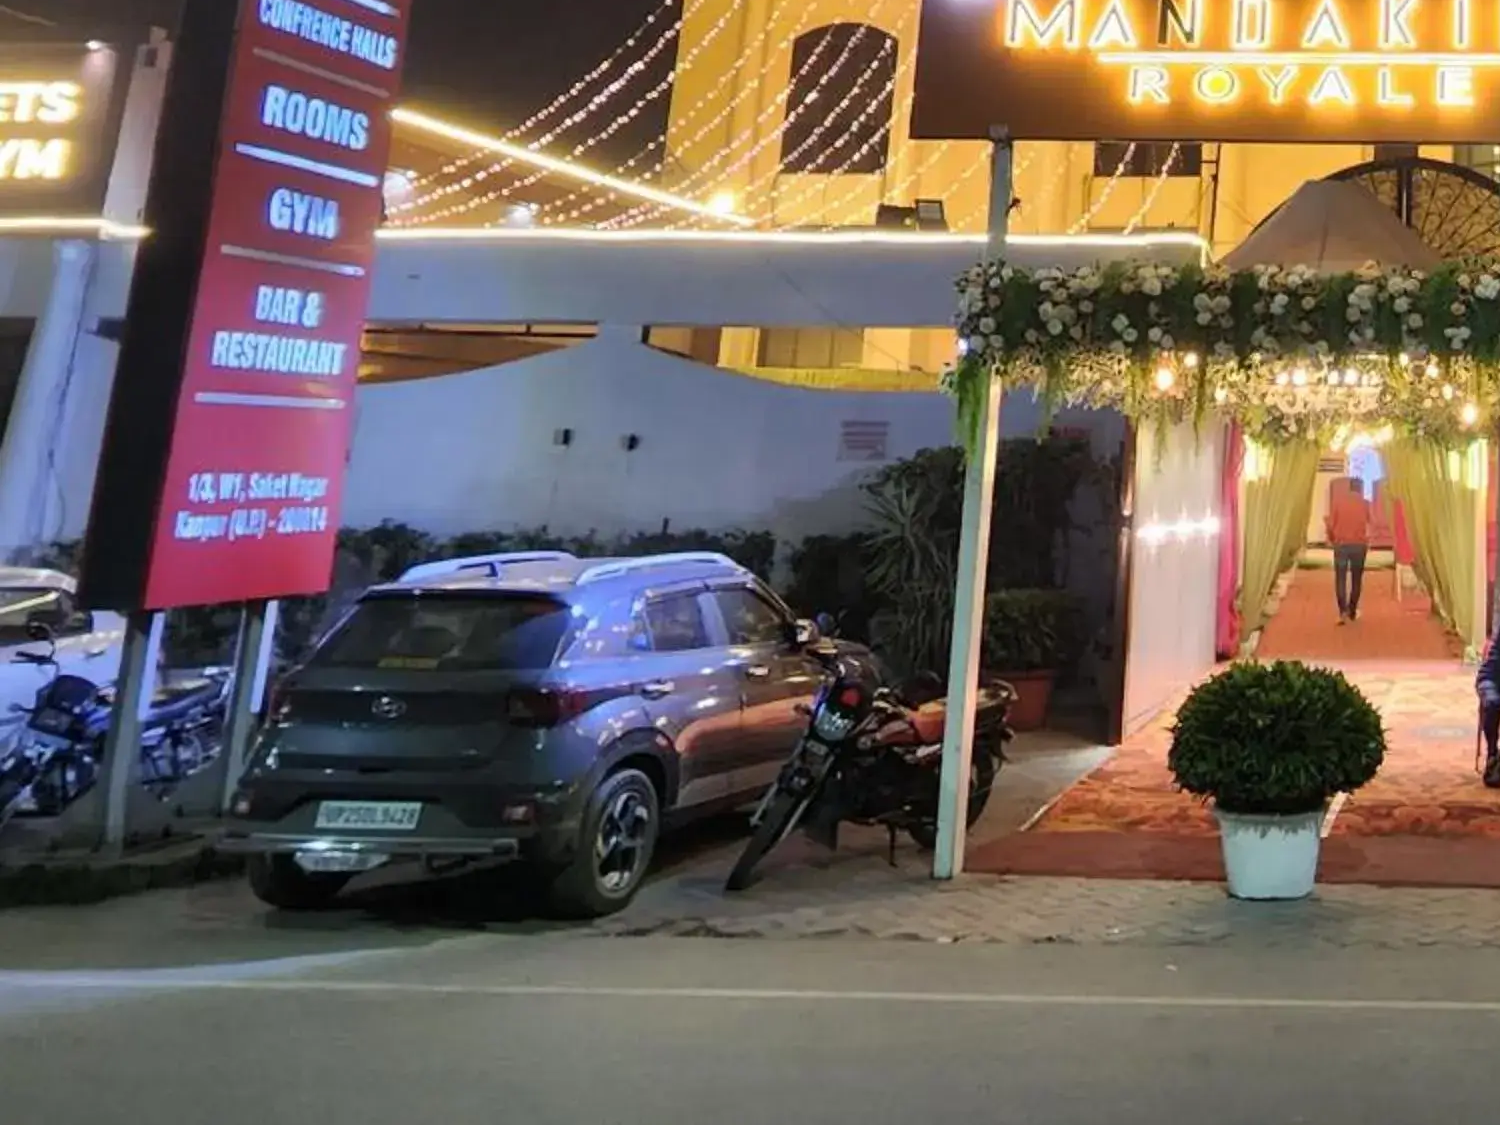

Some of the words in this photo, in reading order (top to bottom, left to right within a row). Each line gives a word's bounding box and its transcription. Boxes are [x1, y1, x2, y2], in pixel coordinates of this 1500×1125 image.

[349, 21, 398, 70] HALLS
[1126, 63, 1478, 106] ROYALE
[262, 84, 370, 151] ROOMS
[269, 187, 340, 240] GYM
[255, 284, 303, 325] BAR
[301, 291, 324, 328] &
[211, 330, 346, 376] RESTAURANT
[248, 472, 289, 499] Saket
